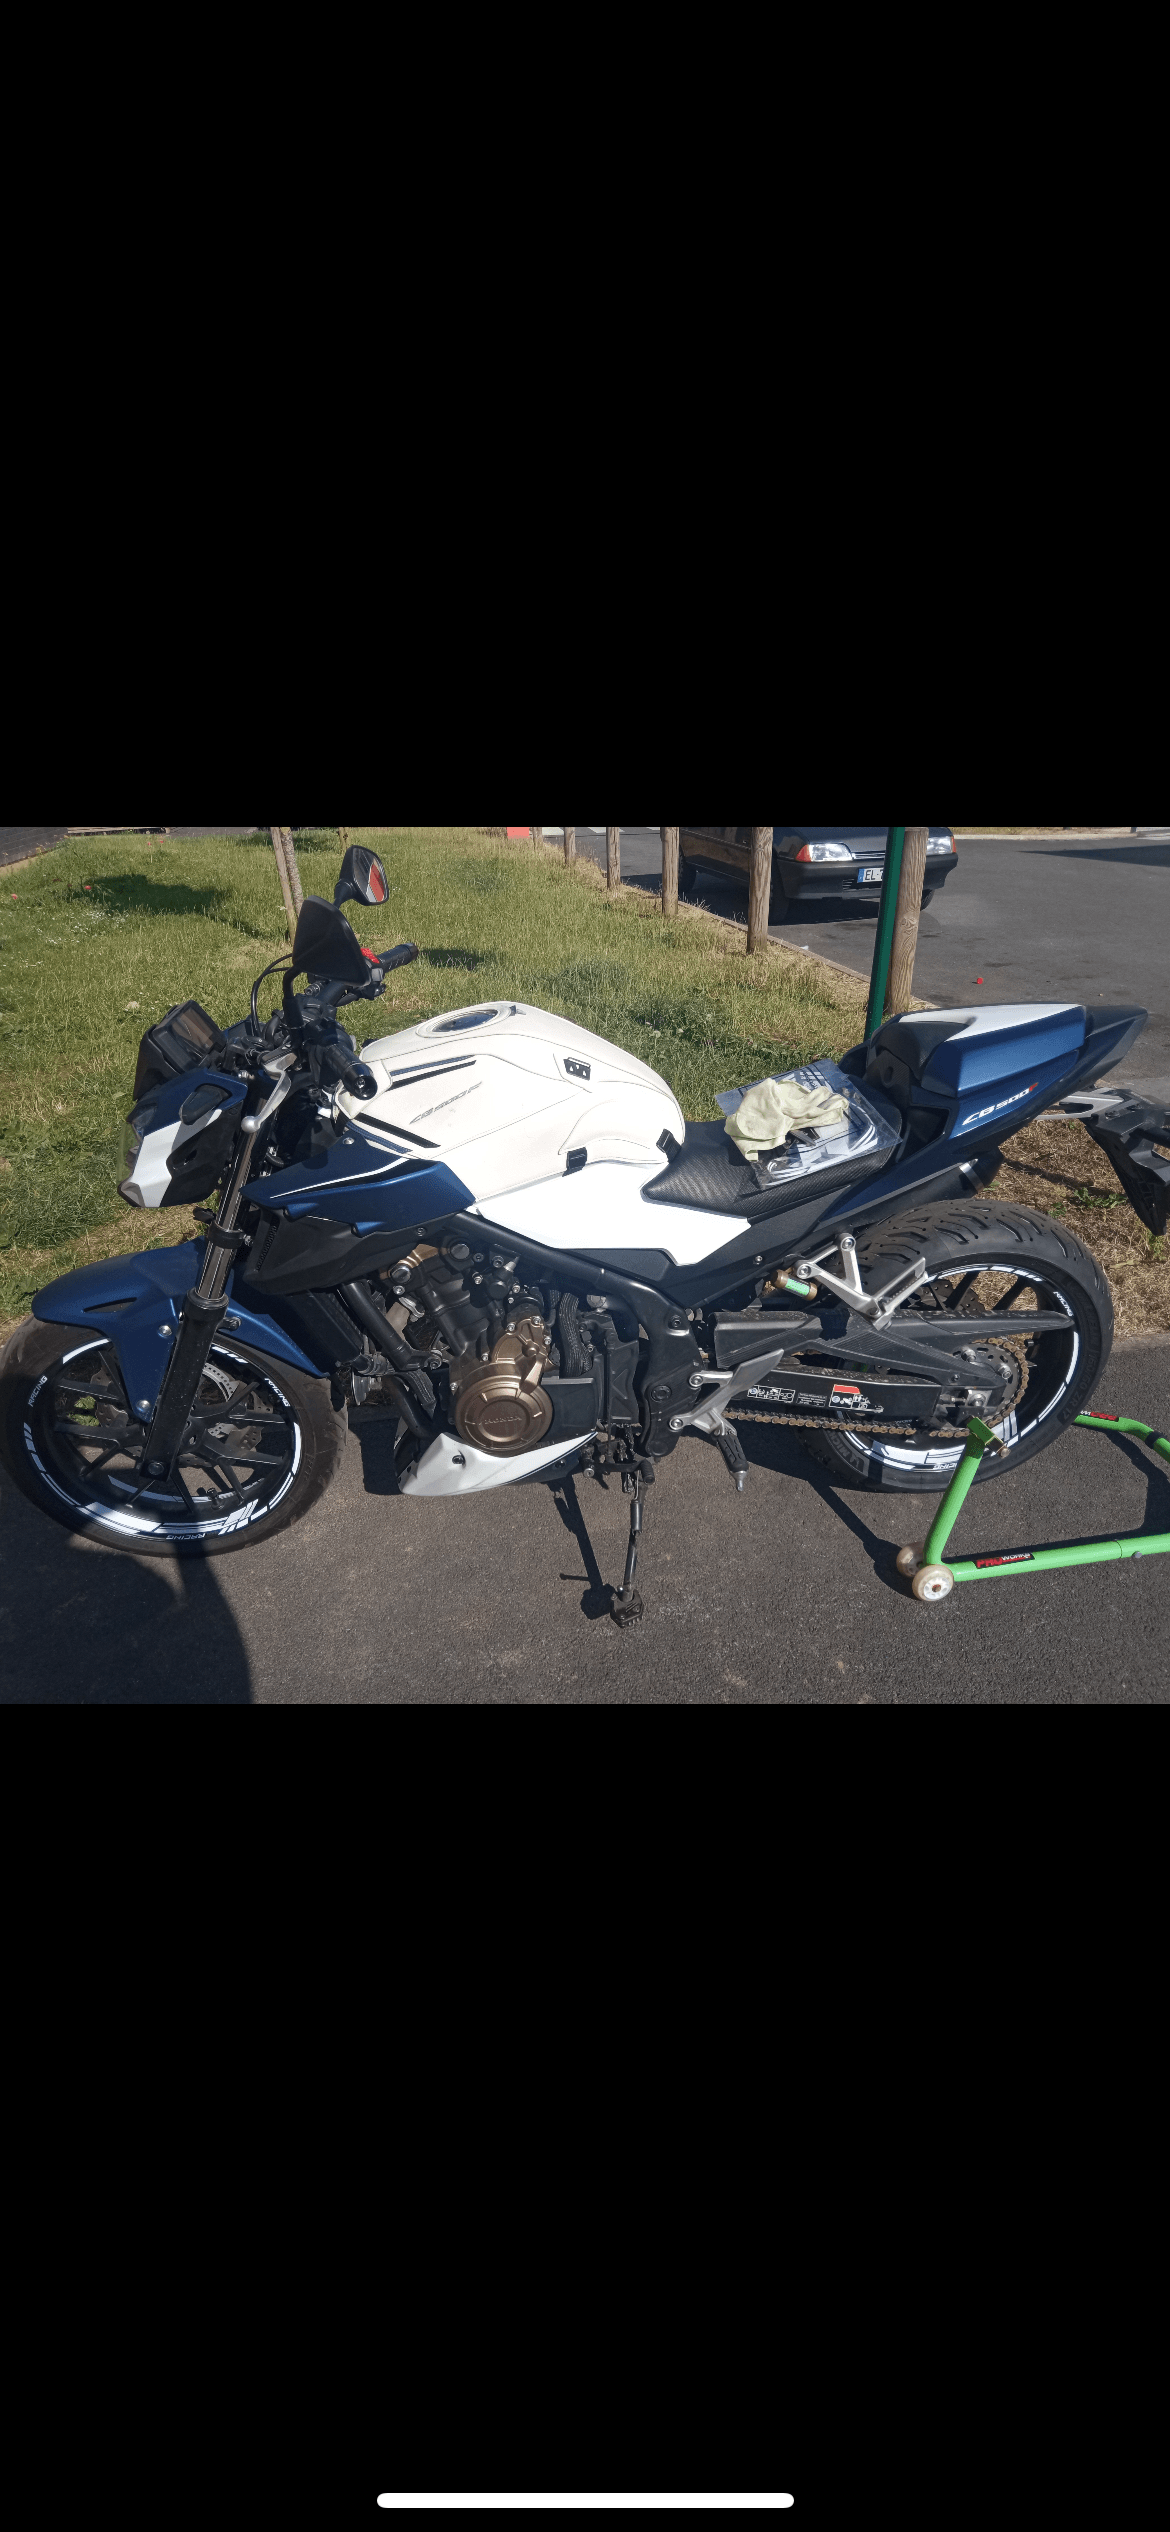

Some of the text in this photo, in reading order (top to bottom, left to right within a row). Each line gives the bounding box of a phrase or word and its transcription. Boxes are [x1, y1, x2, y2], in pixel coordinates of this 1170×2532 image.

[1053, 1291, 1074, 1317] RACING
[28, 1375, 48, 1407] RACING
[264, 1378, 290, 1407] RACING
[166, 1532, 206, 1540] RACING
